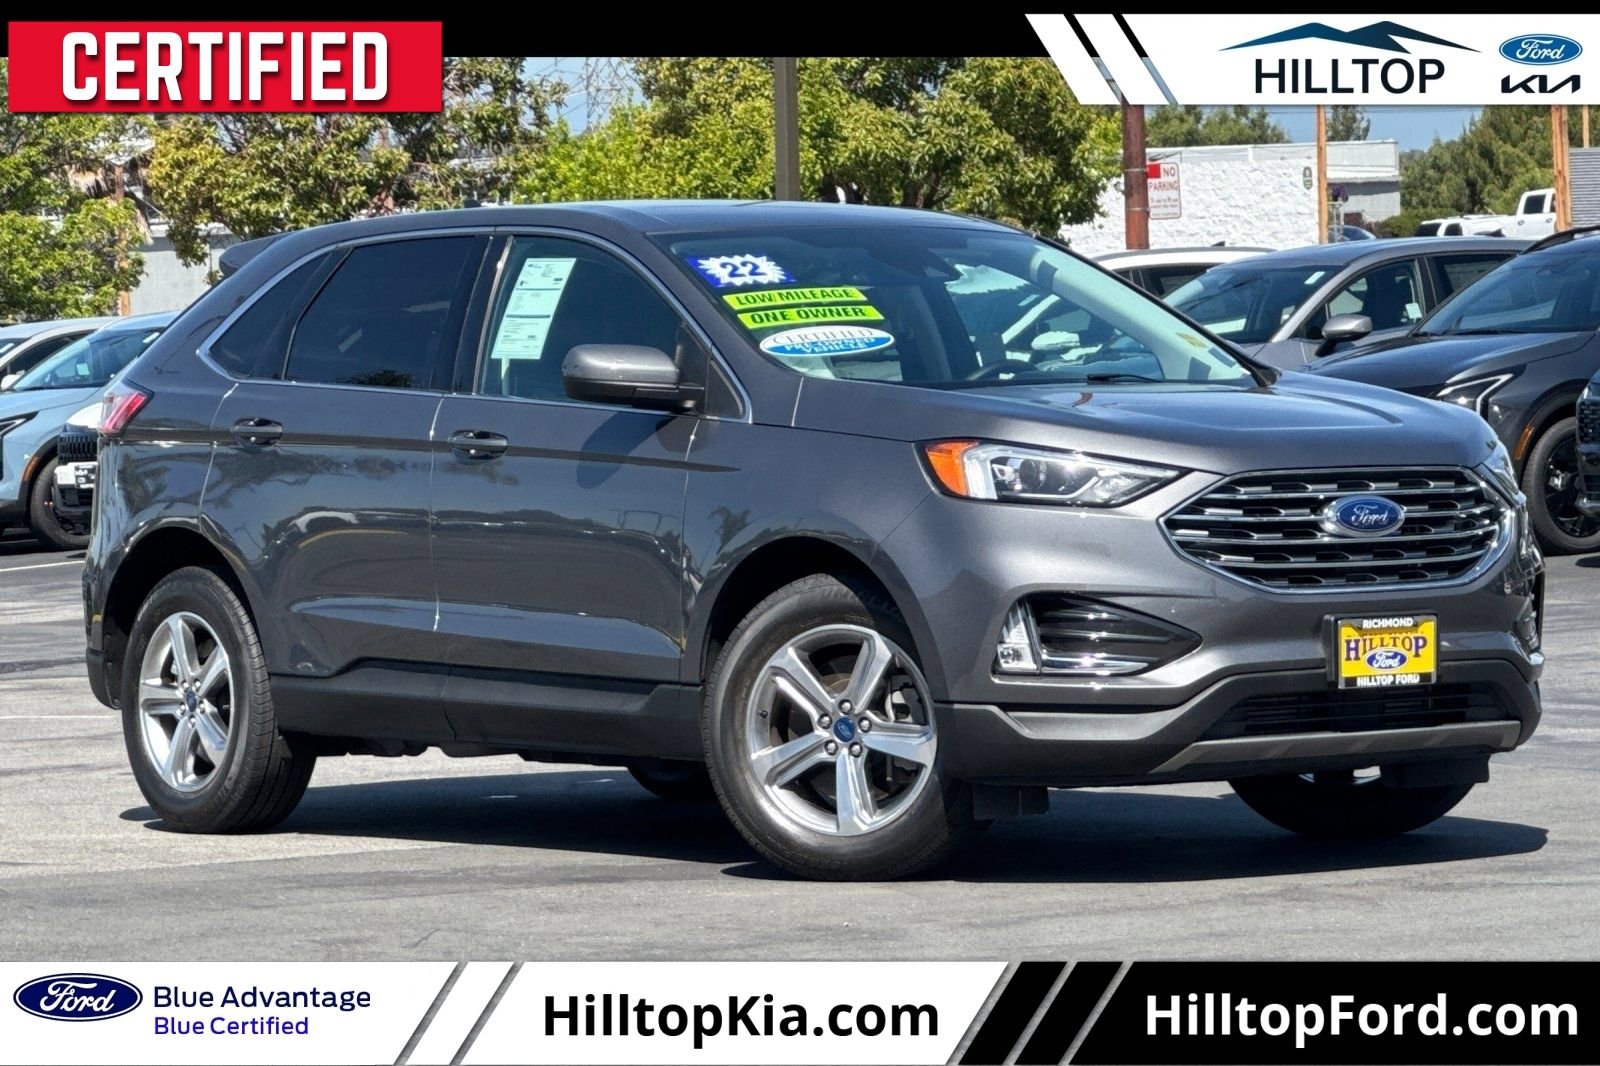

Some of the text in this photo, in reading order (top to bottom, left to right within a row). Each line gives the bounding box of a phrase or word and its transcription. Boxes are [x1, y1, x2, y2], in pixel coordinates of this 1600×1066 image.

[1163, 167, 1176, 177] NO
[1148, 181, 1178, 192] PARKING
[719, 260, 768, 278] 22
[735, 288, 857, 306] LOW MILEAGE
[751, 306, 868, 324] ONE OWNER
[772, 328, 874, 345] CERTIFIED
[802, 341, 869, 353] VEHICLE
[1351, 504, 1389, 526] Ford
[1363, 617, 1414, 629] RICHMOND
[1345, 635, 1428, 662] HILLTOP
[1372, 651, 1401, 668] Ford
[1357, 673, 1420, 687] HILLTOP FORD
